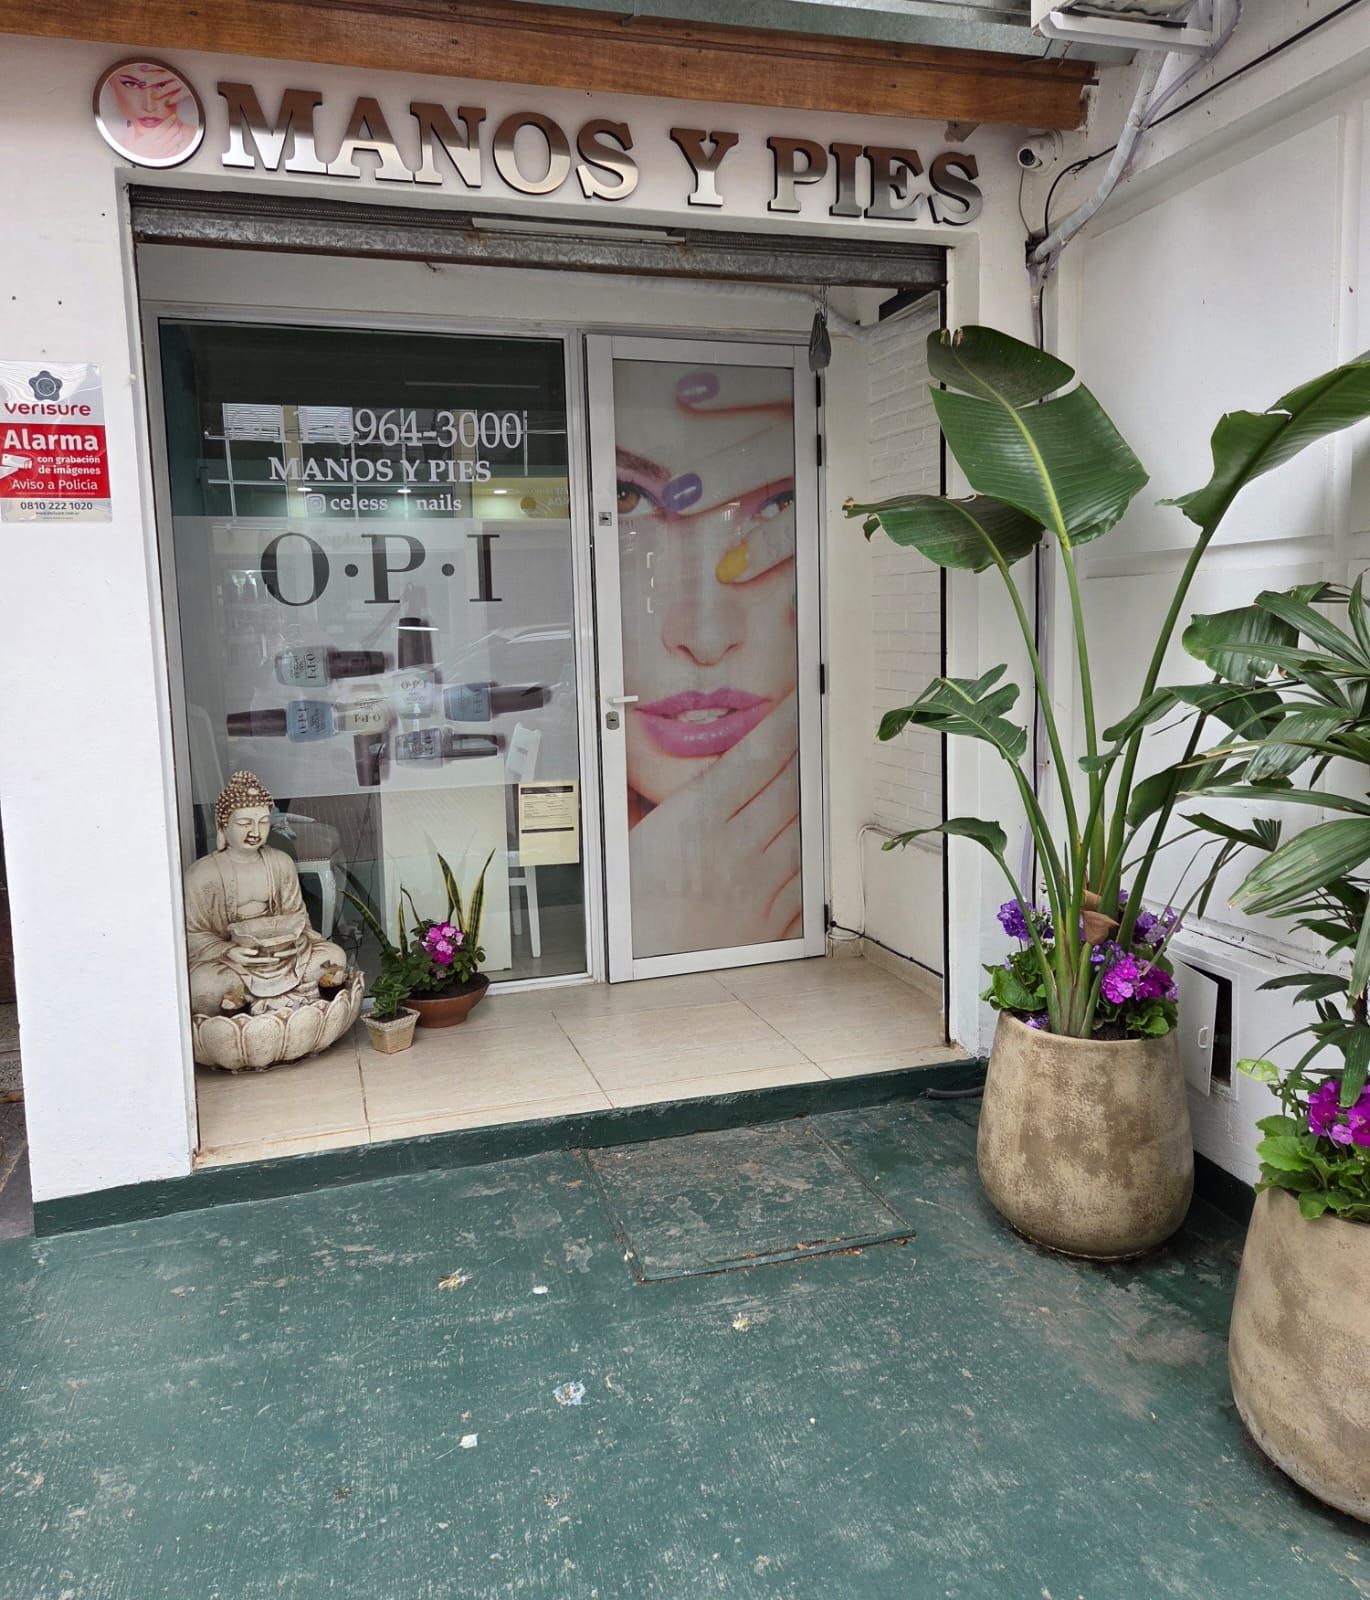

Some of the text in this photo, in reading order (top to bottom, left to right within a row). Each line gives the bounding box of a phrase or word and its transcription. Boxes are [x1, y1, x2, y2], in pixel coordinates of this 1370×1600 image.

[217, 81, 984, 227] MANOS Y PIES
[4, 402, 92, 416] verisure
[3, 428, 99, 450] Alarma
[55, 454, 101, 465] grabación
[38, 464, 102, 477] de imágenes
[267, 456, 492, 483] MANOS Y PIES
[11, 478, 99, 490] Aviso a Policía
[20, 502, 93, 511] 0810 222 1020
[330, 493, 463, 511] celess nails
